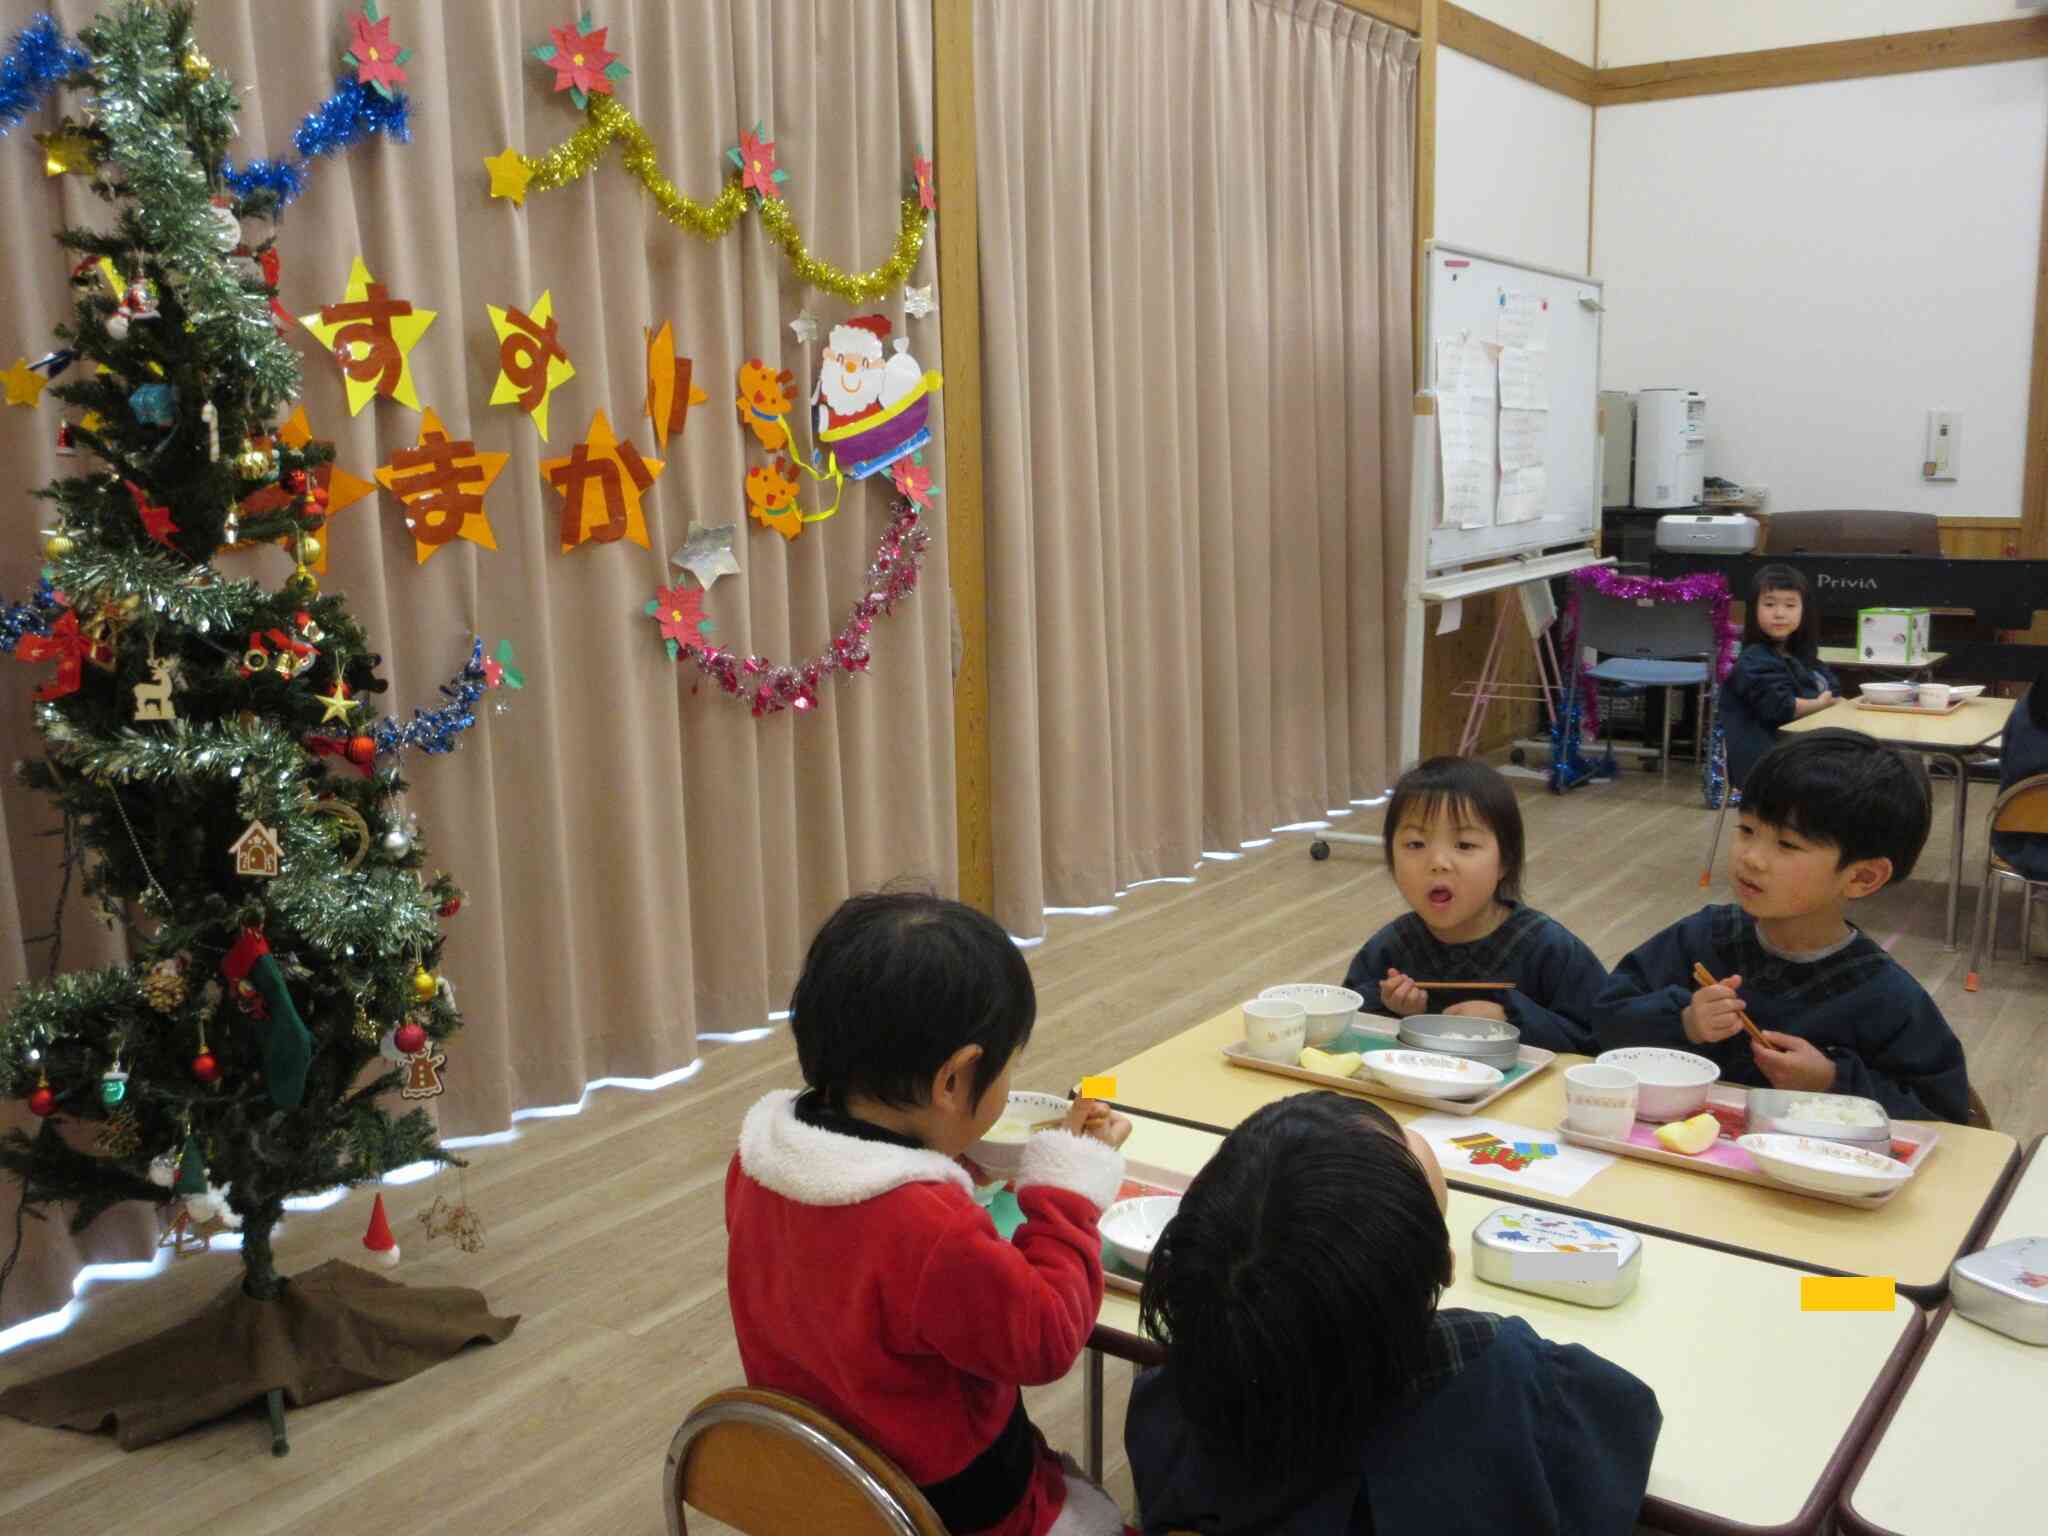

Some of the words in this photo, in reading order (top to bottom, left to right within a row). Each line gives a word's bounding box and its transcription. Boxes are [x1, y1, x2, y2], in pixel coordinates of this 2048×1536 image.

[320, 281, 413, 398] す
[389, 431, 485, 545] ま
[550, 439, 655, 545] か
